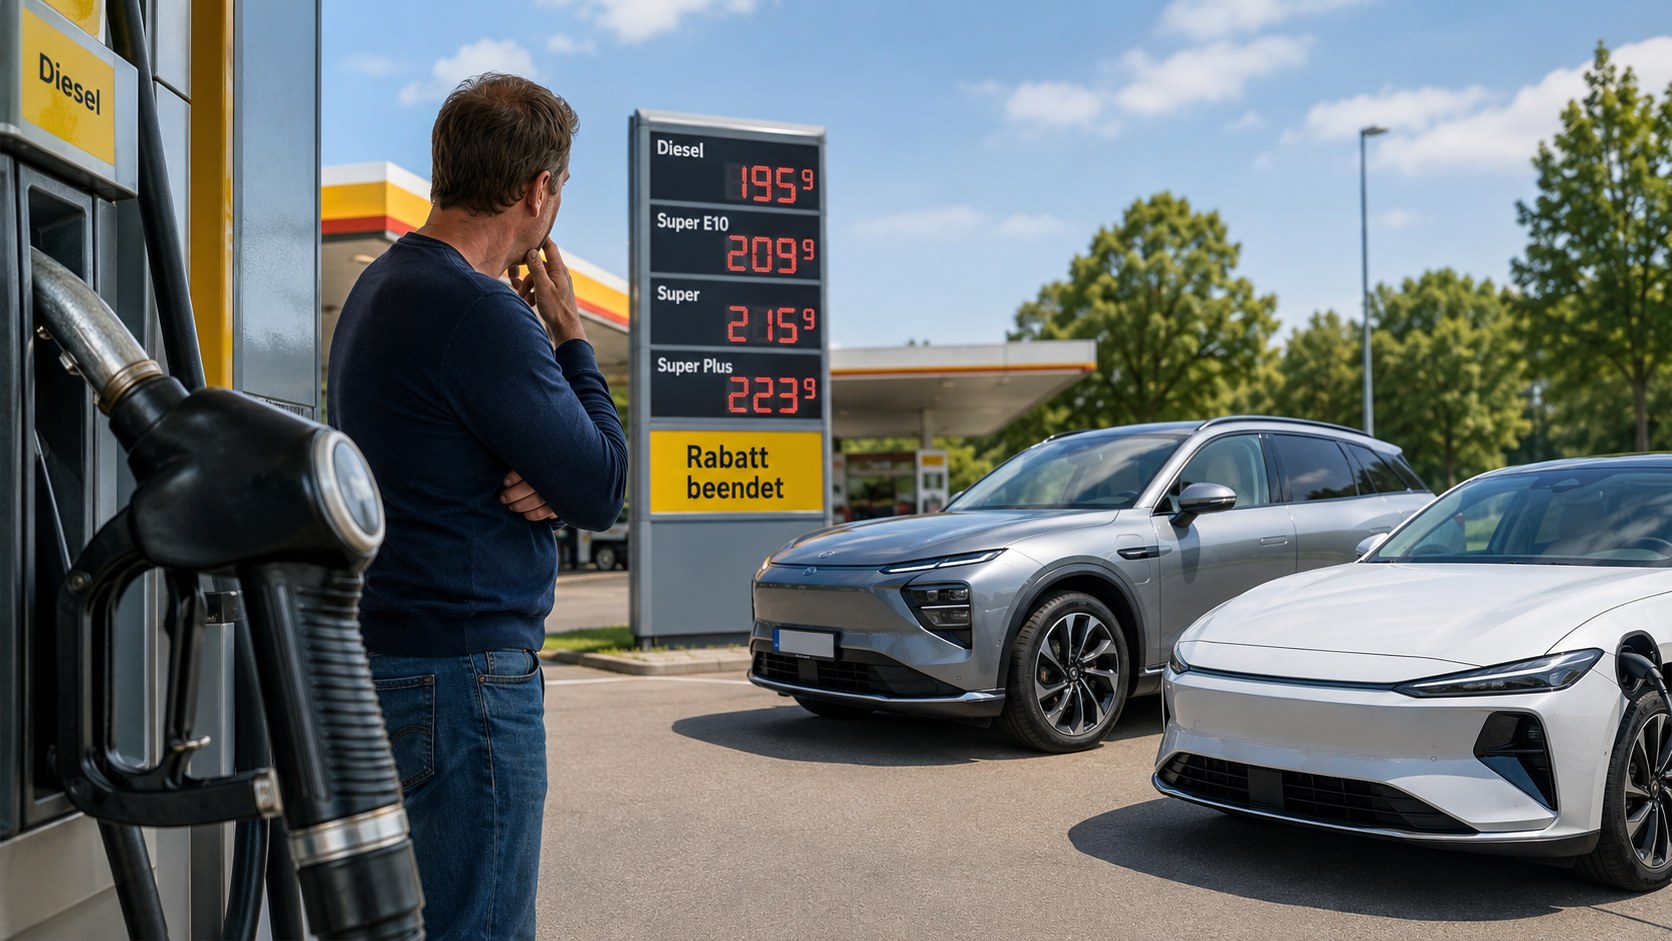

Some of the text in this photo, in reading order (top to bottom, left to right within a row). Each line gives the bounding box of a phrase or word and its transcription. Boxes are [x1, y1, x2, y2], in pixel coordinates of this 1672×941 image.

[39, 52, 101, 115] Diesel
[658, 140, 703, 158] Diesel
[658, 213, 728, 232] Super E10
[658, 286, 700, 304] Super
[658, 358, 732, 375] Super Plus
[688, 445, 768, 468] Rabatt
[688, 475, 783, 499] beendet
